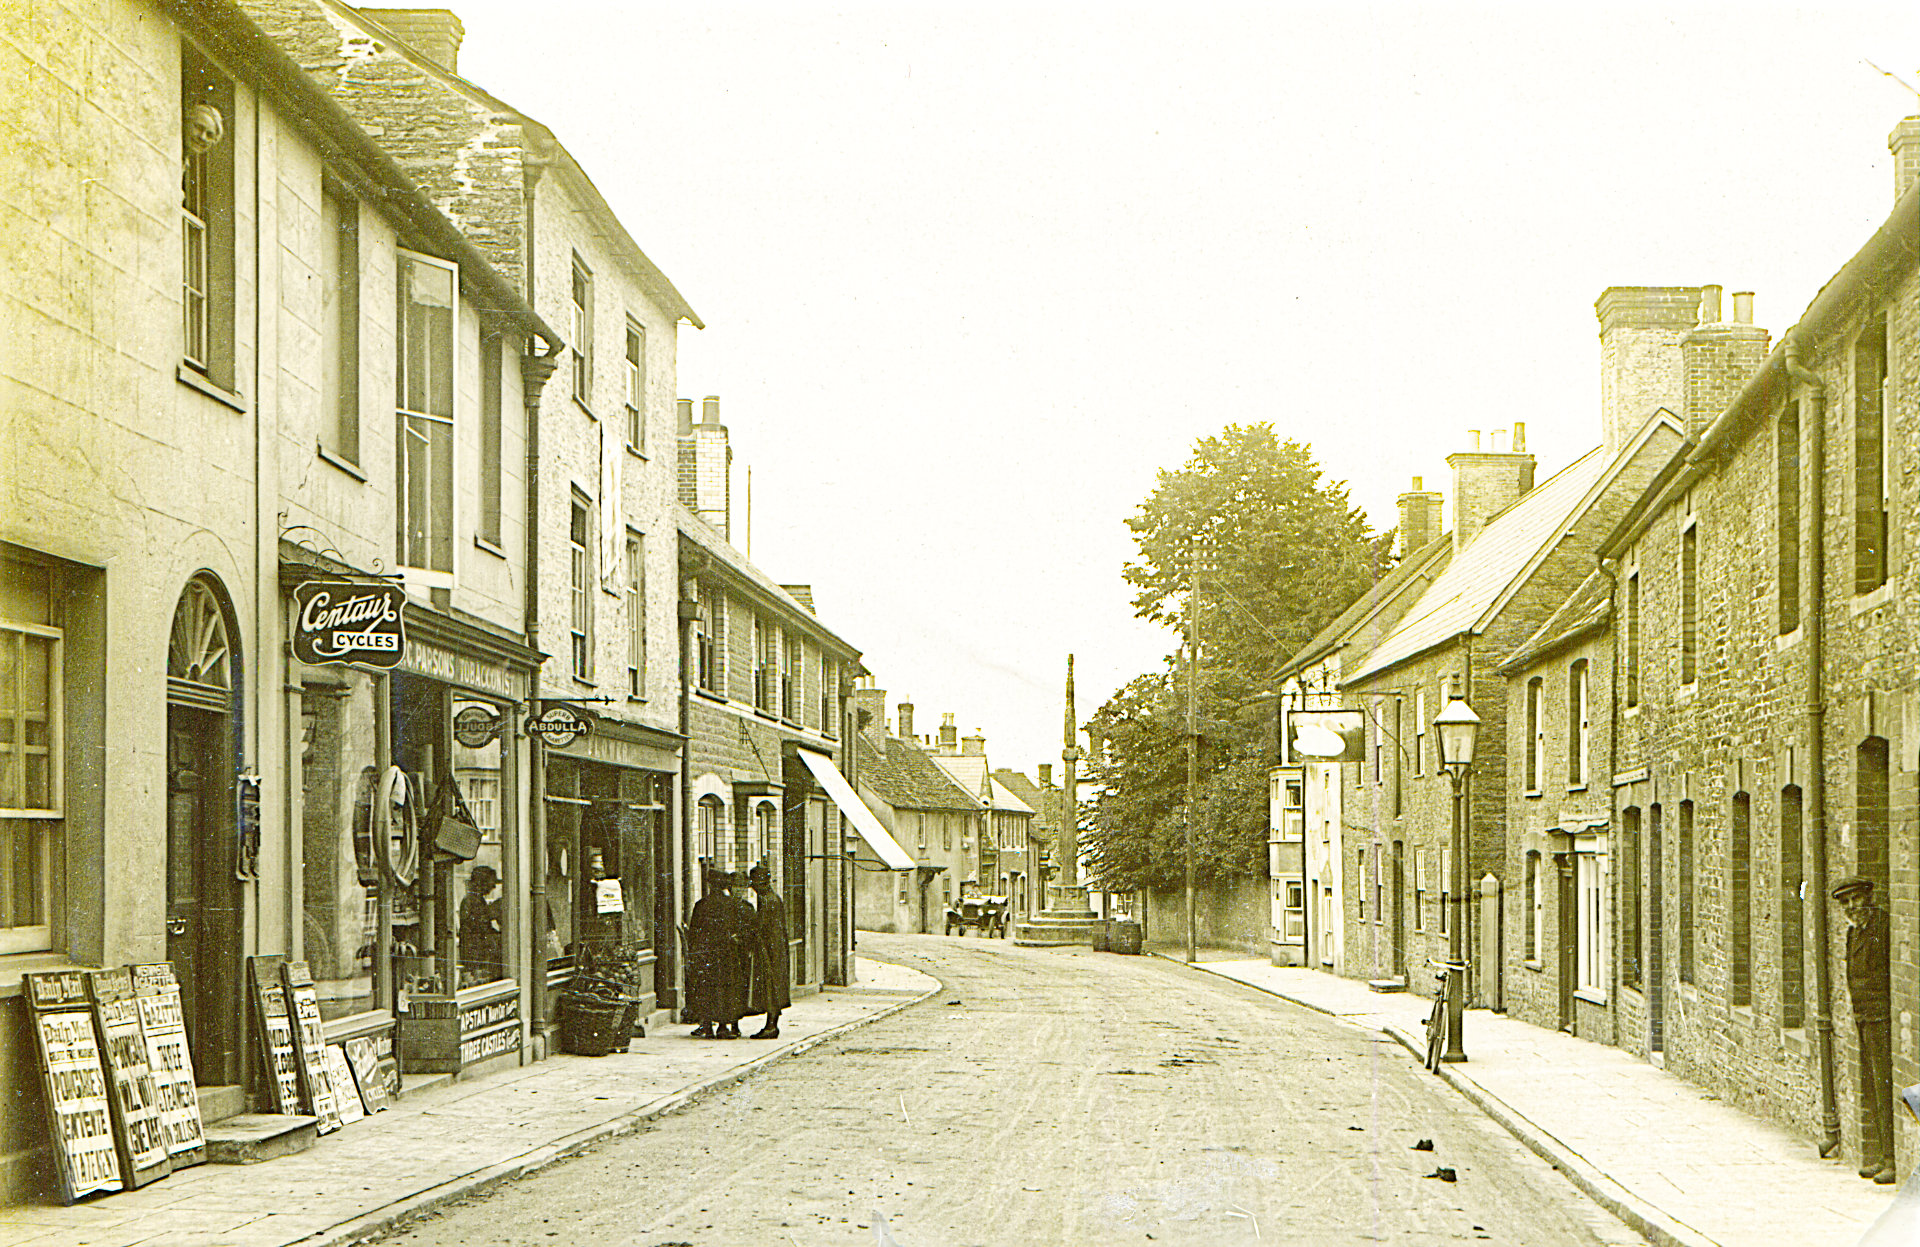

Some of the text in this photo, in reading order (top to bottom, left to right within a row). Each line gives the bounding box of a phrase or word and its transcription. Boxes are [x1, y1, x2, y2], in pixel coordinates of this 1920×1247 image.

[302, 591, 397, 633] Centaur
[337, 634, 394, 648] CYCLES
[416, 642, 455, 680] PARSONS
[460, 658, 515, 697] TOBACCONIST
[529, 720, 587, 735] ABDULLA
[546, 710, 571, 721] SUPERB
[33, 975, 64, 1003] Daily
[61, 974, 84, 998] Mail
[141, 994, 181, 1026] GAZETTE
[43, 1020, 93, 1046] Daily Mail
[157, 1043, 182, 1071] THREE
